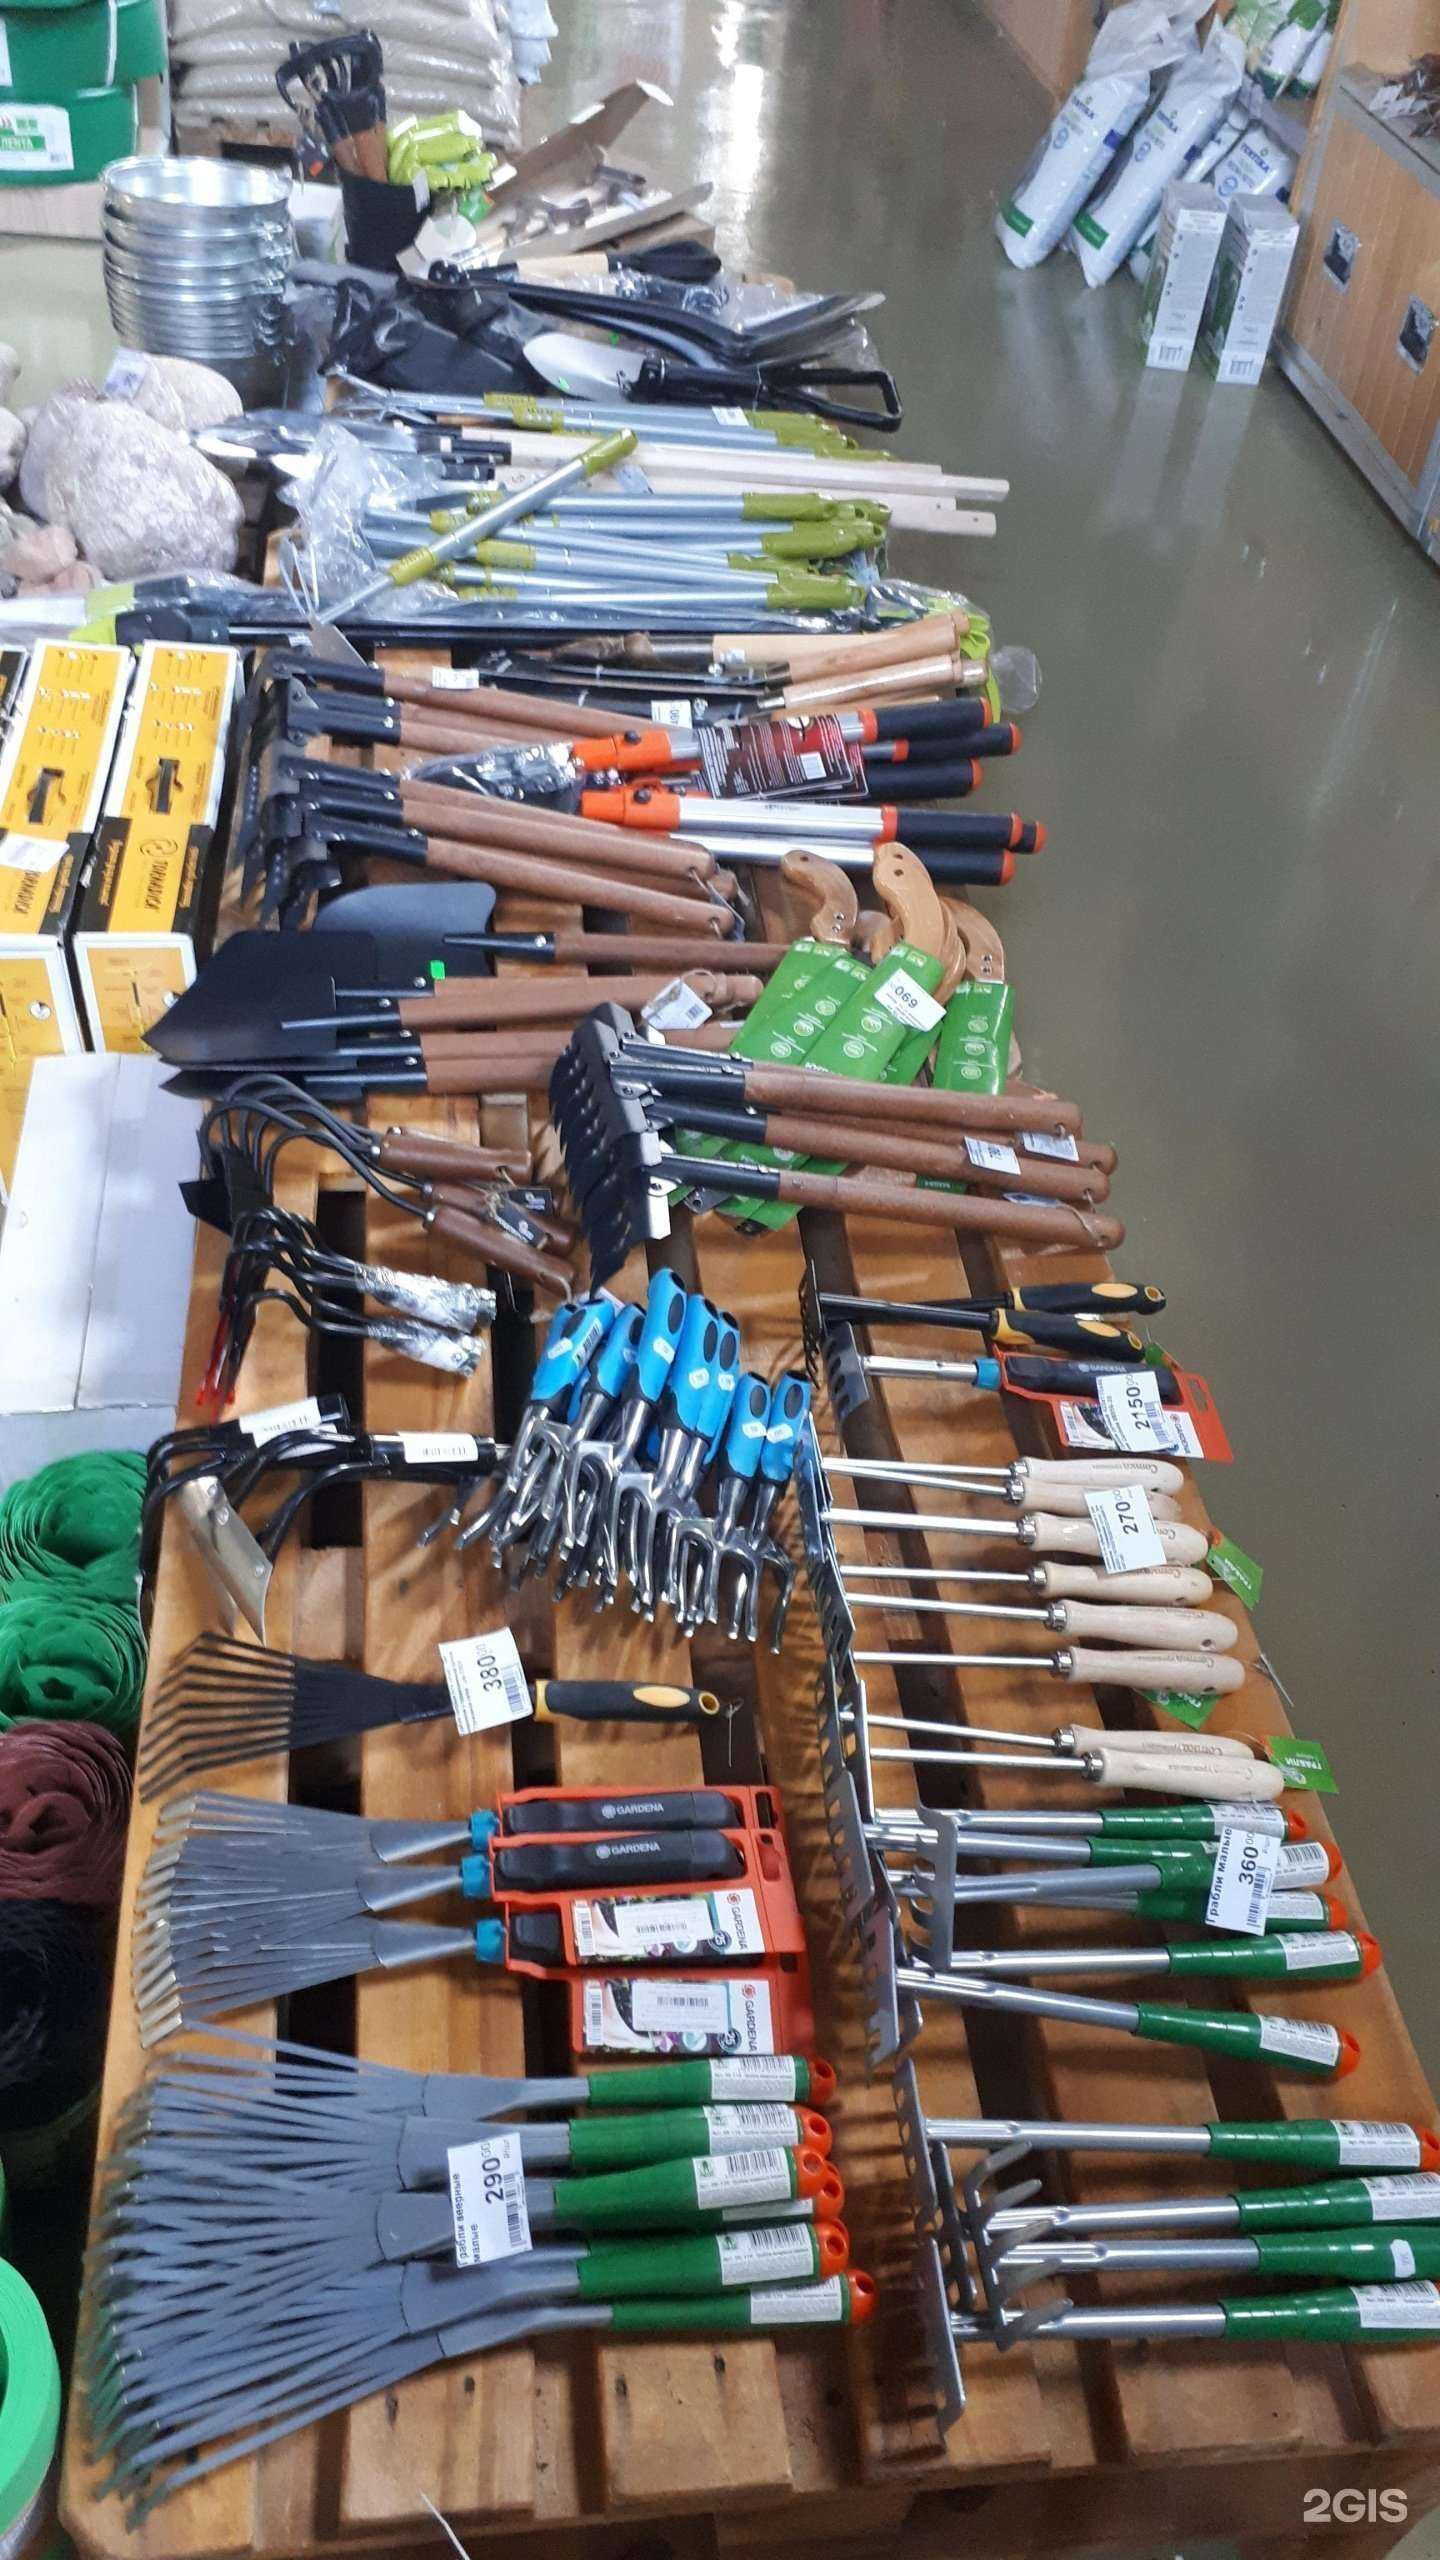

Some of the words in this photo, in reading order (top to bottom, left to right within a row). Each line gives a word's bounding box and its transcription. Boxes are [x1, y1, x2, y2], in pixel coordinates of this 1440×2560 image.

[1126, 1386, 1151, 1431] 2150
[1115, 1501, 1139, 1535] 270
[477, 1655, 502, 1692] 380
[615, 1802, 664, 1816] GARDENA
[611, 1842, 662, 1855] GARDENA
[1238, 1846, 1259, 1885] 360
[731, 1906, 748, 1950] GARDENA
[744, 2000, 759, 2052] GARDENA
[481, 2157, 505, 2205] 290
